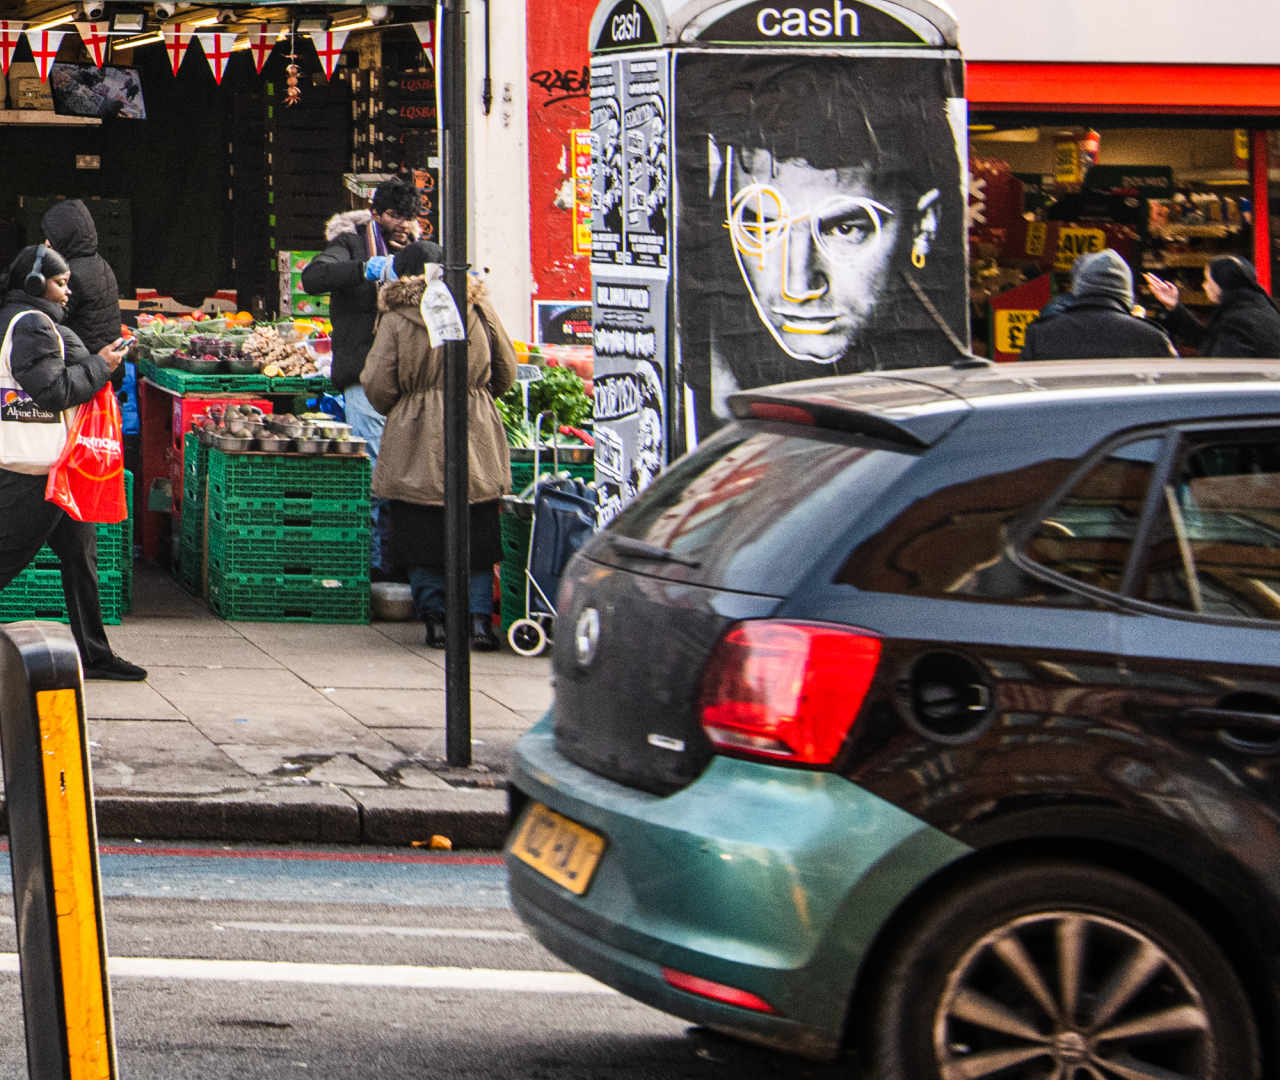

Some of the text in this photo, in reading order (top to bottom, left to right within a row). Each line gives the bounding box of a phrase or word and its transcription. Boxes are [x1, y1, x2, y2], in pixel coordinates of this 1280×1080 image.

[611, 4, 641, 41] cash
[756, 0, 861, 37] cash
[6, 407, 54, 419] Alpine Peaks
